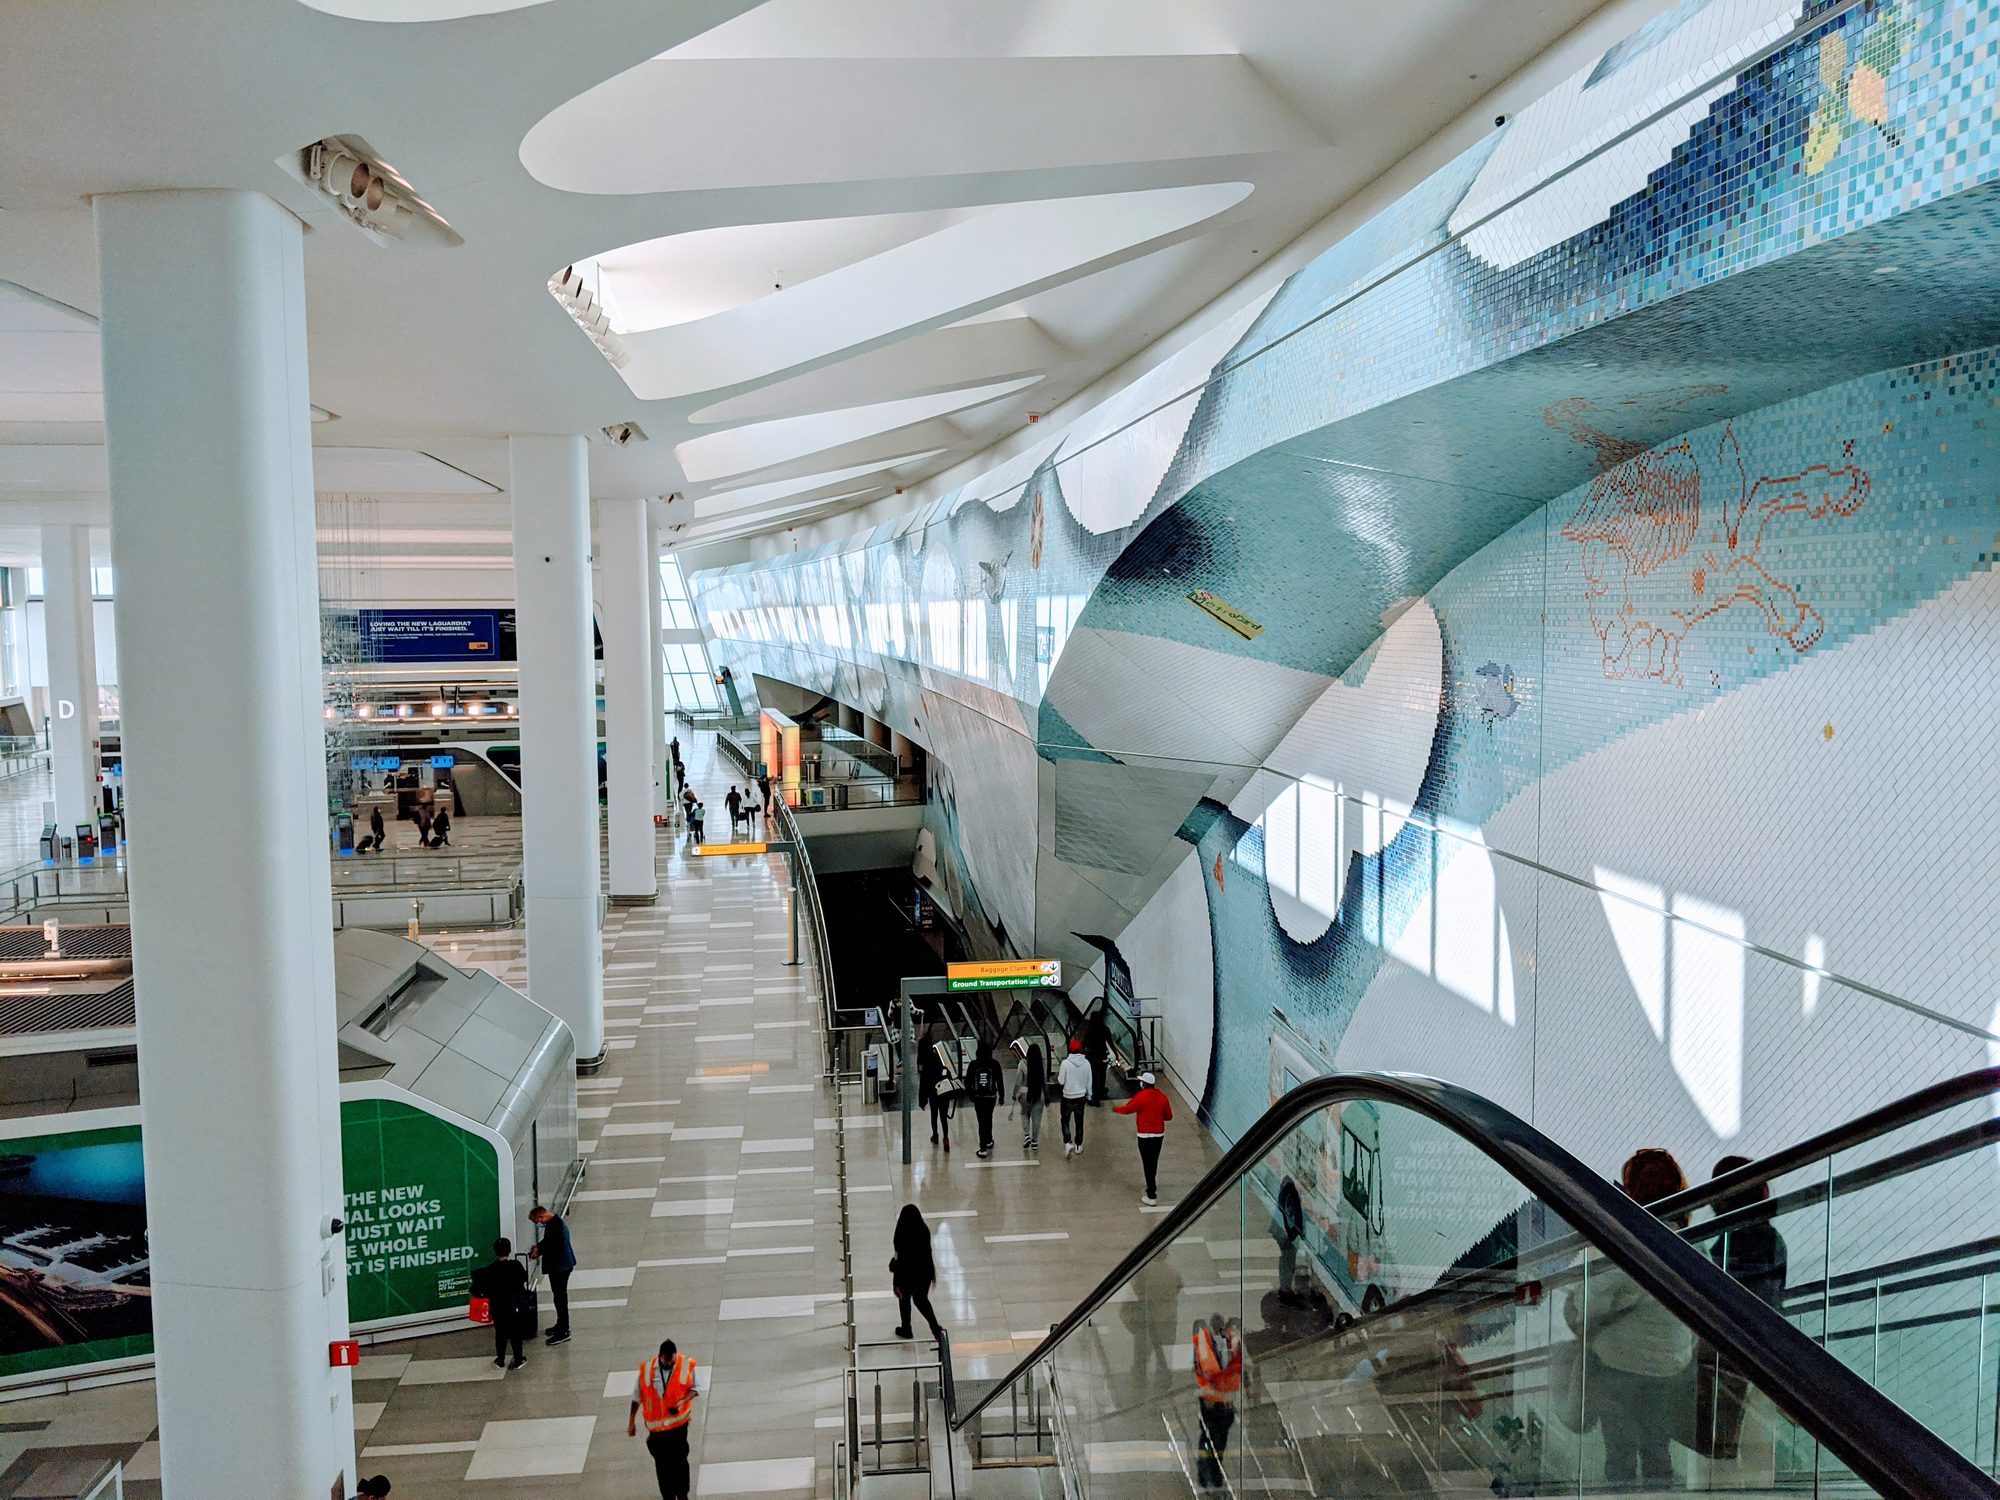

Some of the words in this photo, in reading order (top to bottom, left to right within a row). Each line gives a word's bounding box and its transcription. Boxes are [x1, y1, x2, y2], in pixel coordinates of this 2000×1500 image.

[58, 700, 75, 719] D
[979, 979, 1028, 988] Transportation
[344, 1191, 376, 1207] THE
[381, 1185, 424, 1203] NEW
[379, 1200, 441, 1220] LOOKS
[348, 1223, 392, 1241] JUST
[396, 1216, 445, 1235] WAIT
[361, 1235, 428, 1257] WHOLE
[368, 1259, 385, 1273] IS
[389, 1246, 479, 1270] FINISHED.
